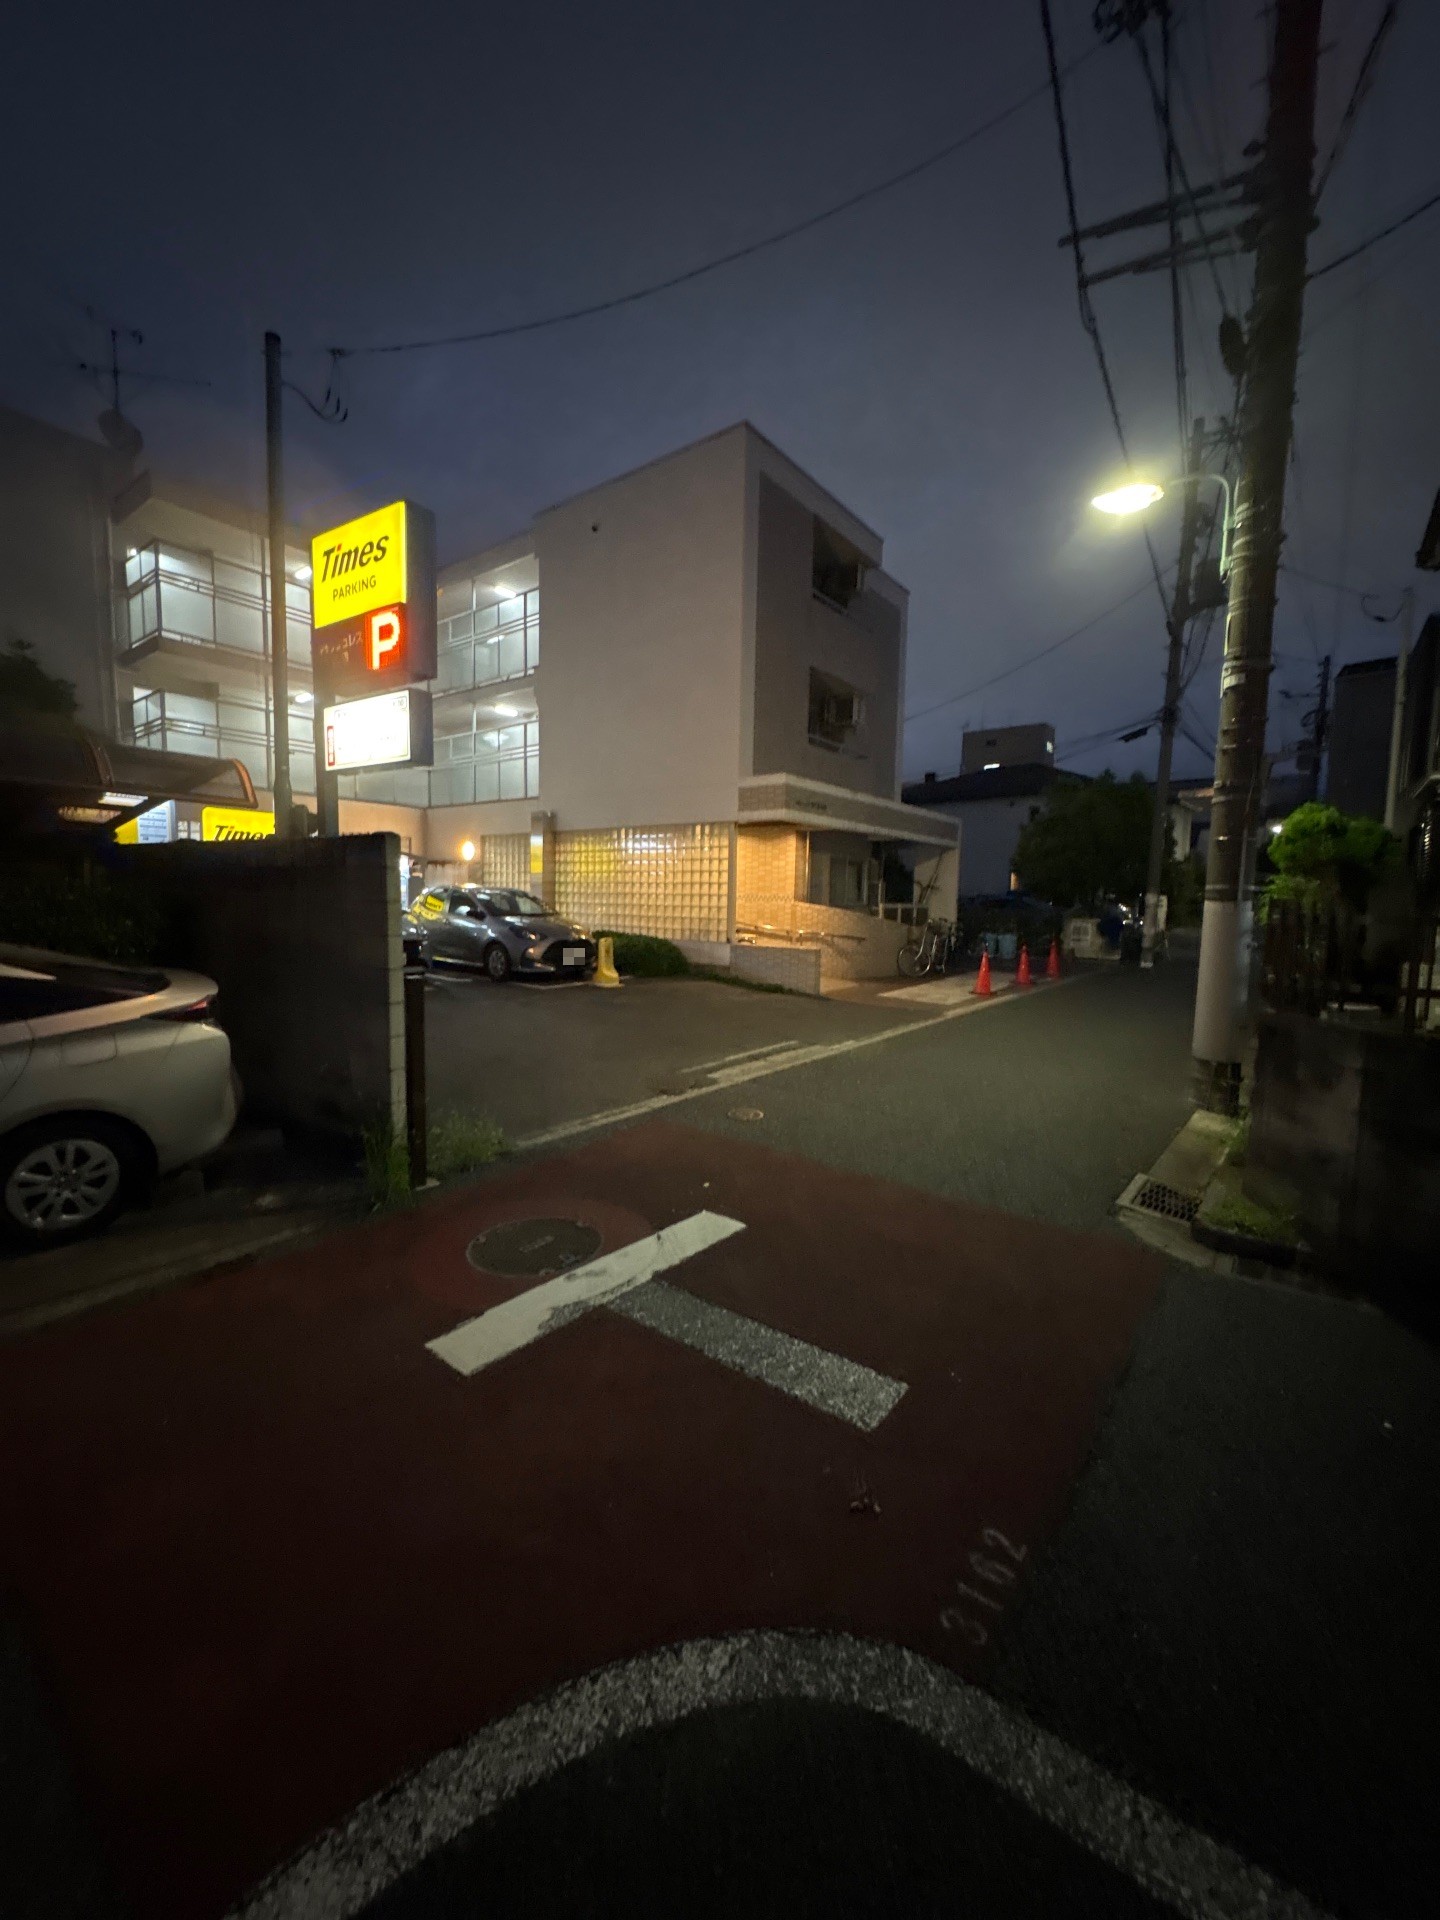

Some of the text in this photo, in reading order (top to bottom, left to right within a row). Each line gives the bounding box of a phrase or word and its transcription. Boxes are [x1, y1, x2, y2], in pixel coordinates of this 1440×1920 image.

[321, 535, 389, 583] Times
[332, 575, 377, 602] PARKING
[371, 611, 401, 671] P
[940, 1528, 1028, 1646] 3162
